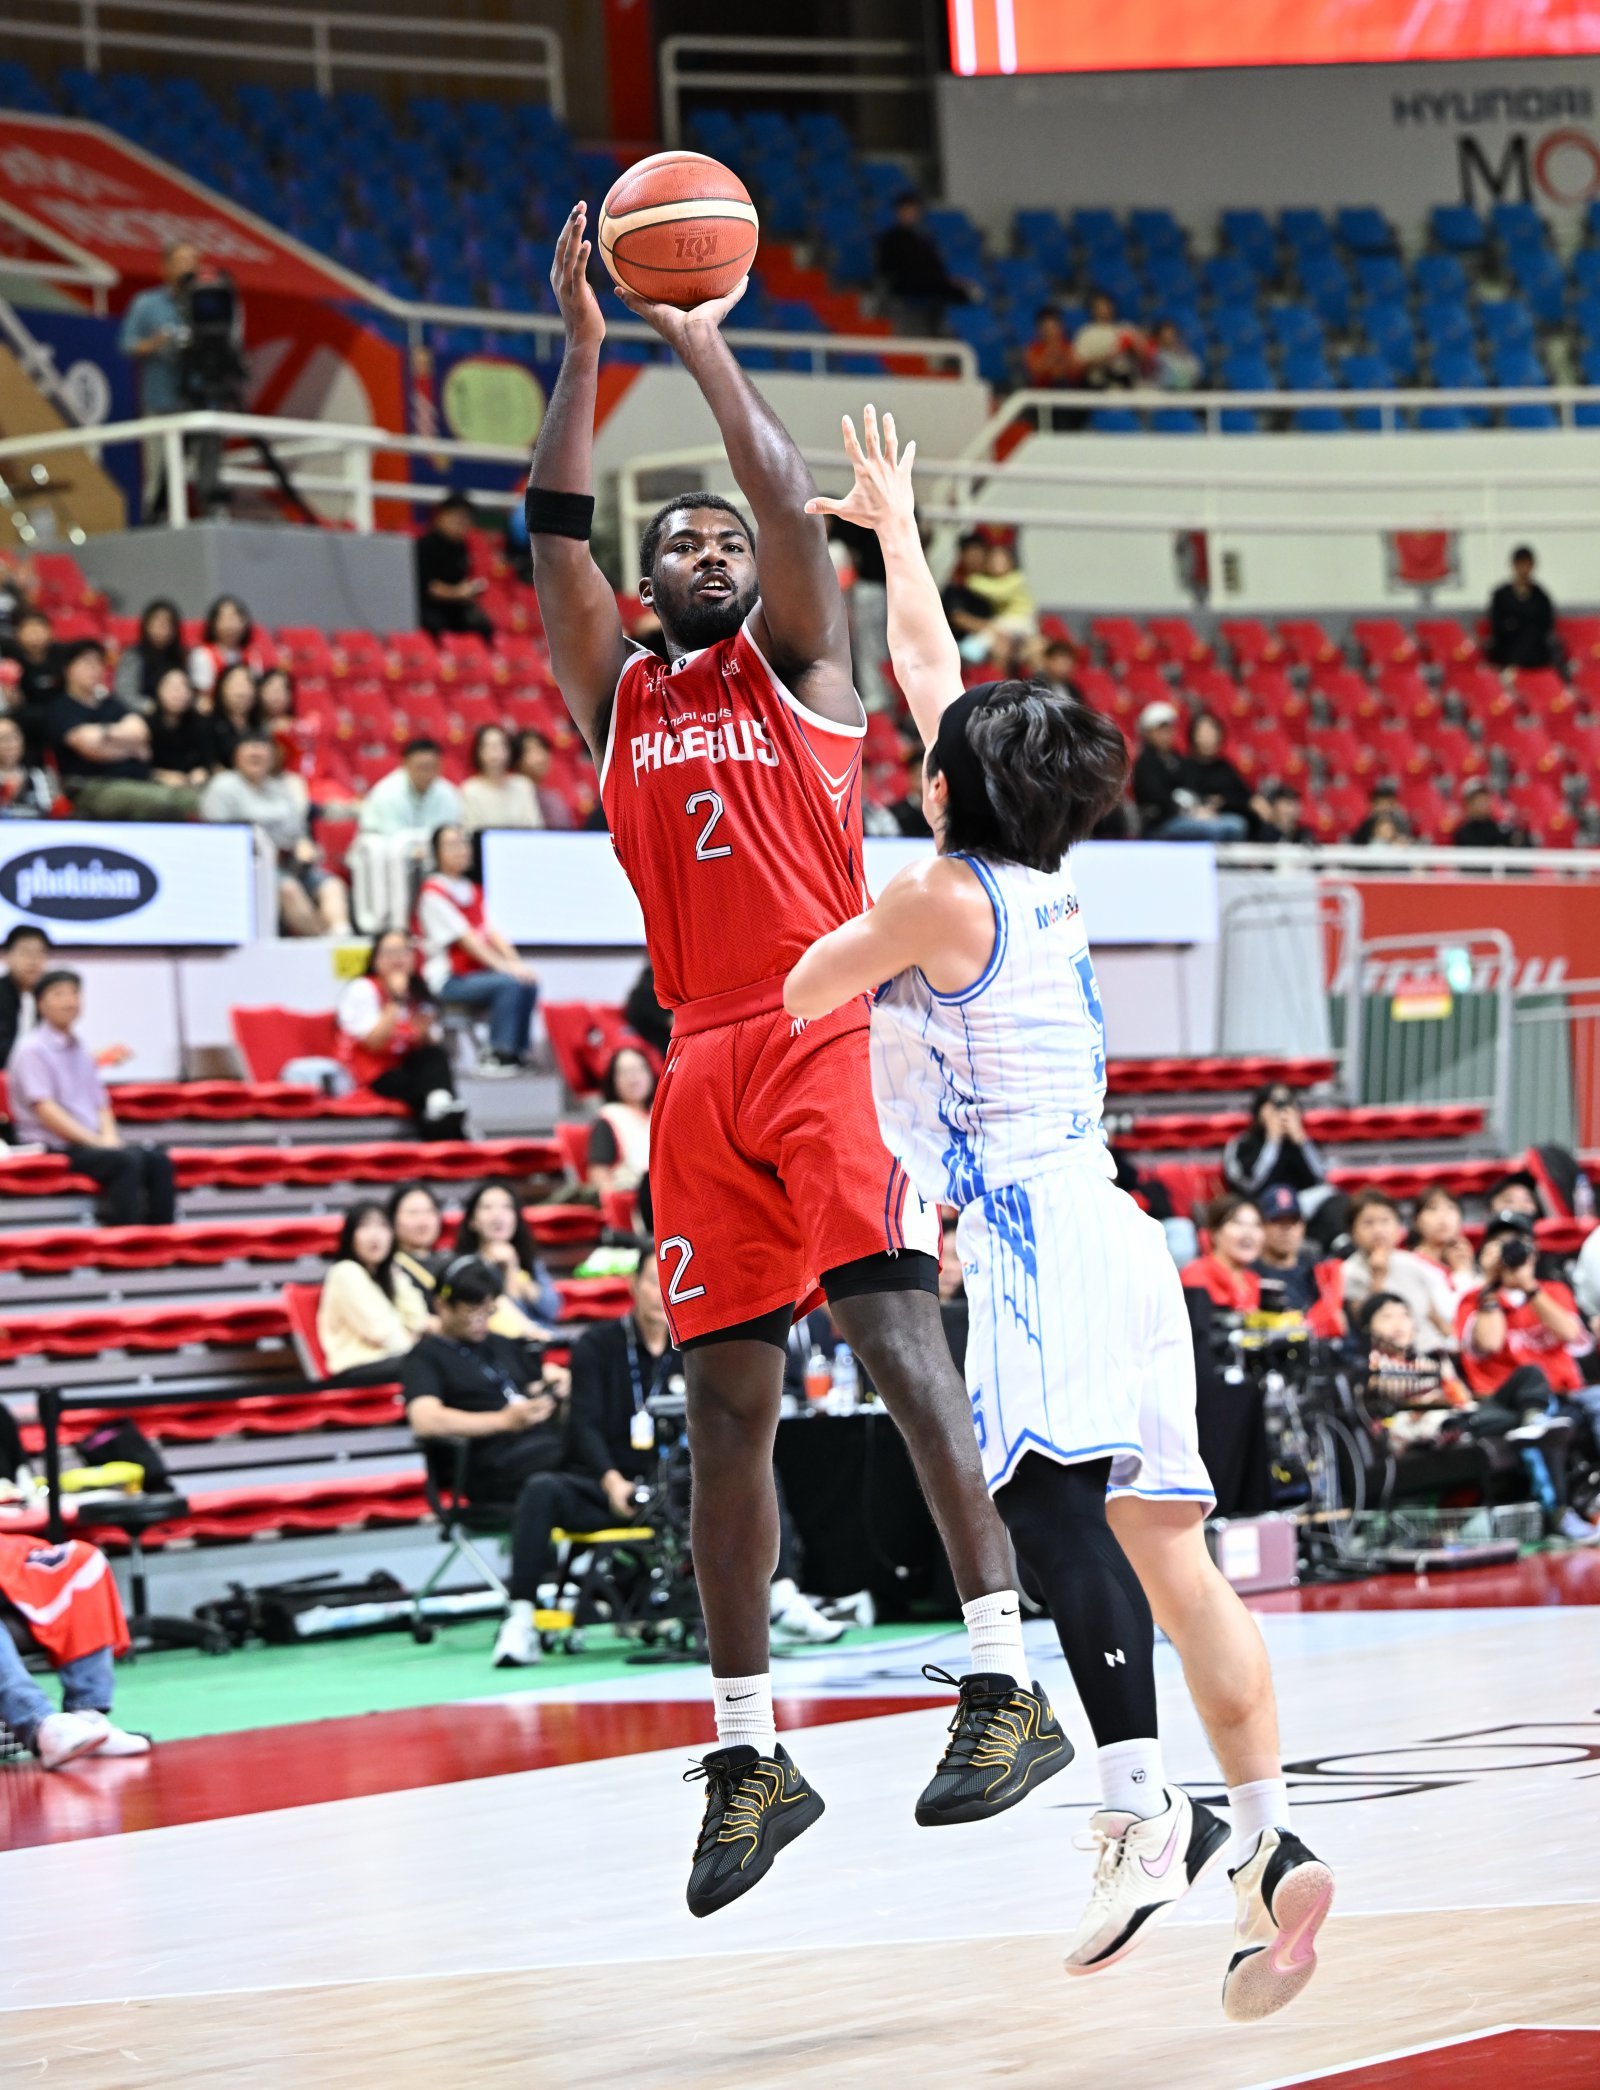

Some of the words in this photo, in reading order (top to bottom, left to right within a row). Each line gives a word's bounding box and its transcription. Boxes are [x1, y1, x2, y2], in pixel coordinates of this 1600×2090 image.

[631, 717, 780, 788] PHOEBUS
[657, 711, 697, 727] HNDAI
[685, 789, 733, 862] 2
[659, 1235, 706, 1305] 2
